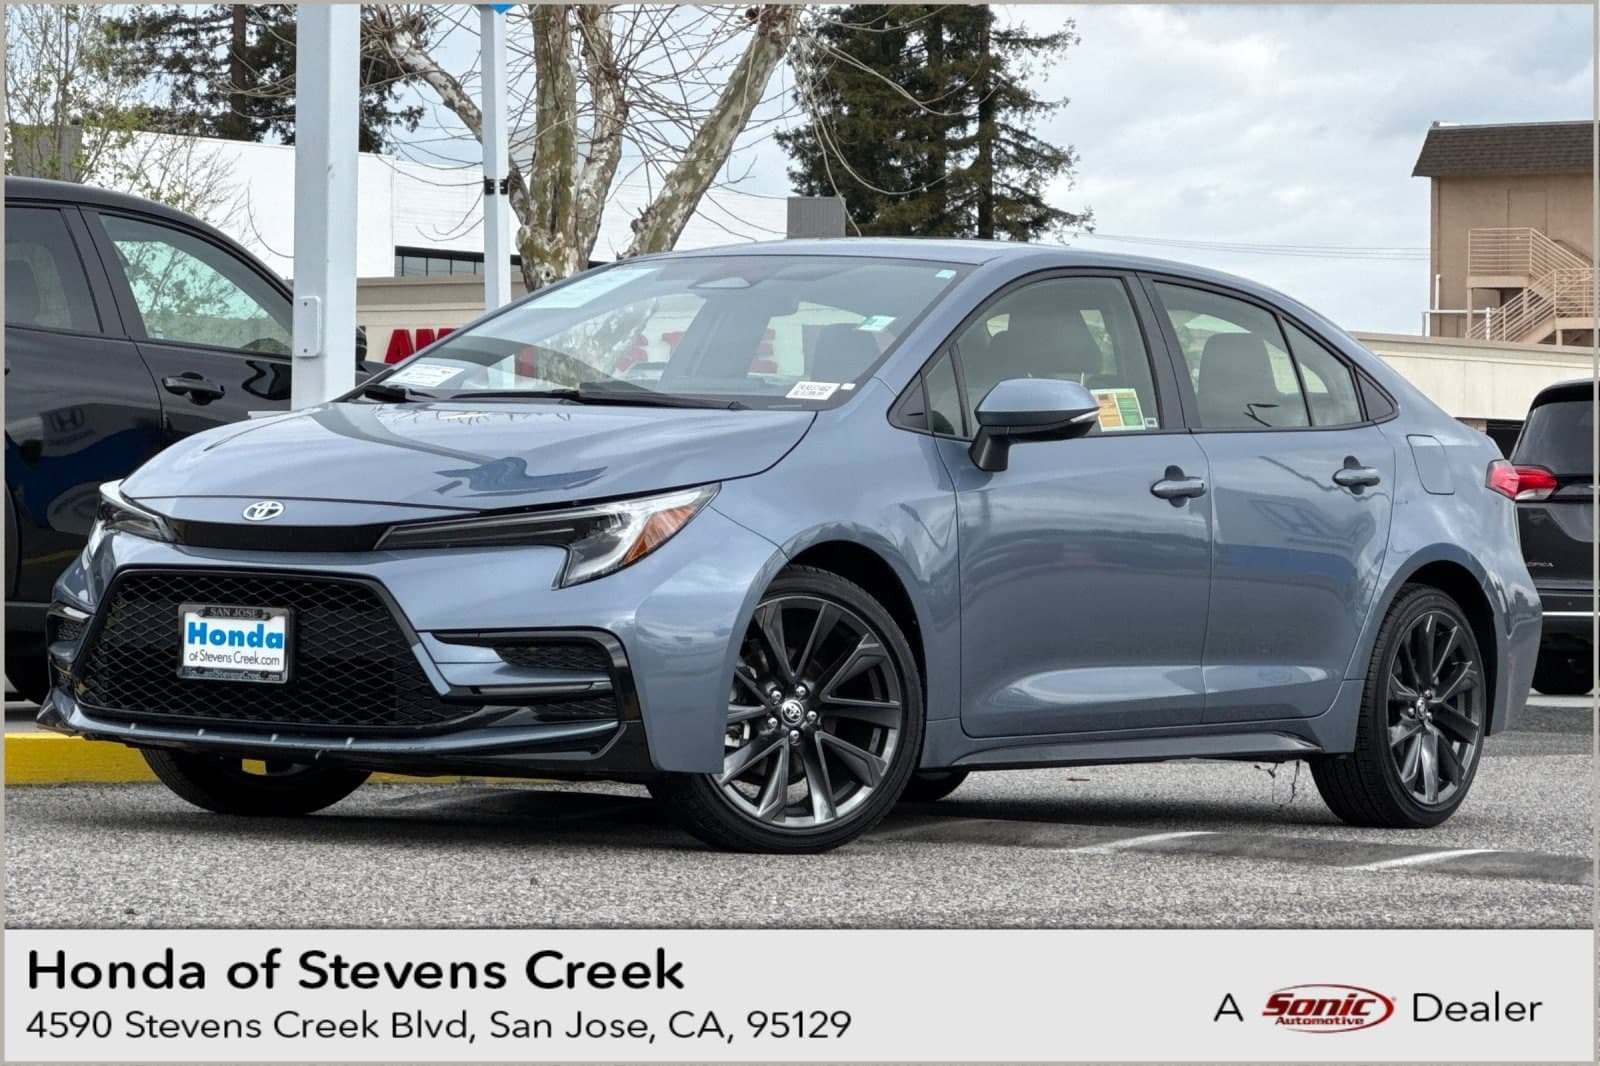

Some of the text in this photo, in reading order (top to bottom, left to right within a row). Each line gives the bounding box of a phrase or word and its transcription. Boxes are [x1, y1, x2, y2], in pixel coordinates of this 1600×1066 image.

[210, 608, 257, 618] SAN JOSE
[187, 622, 284, 649] Honda
[189, 651, 199, 662] of
